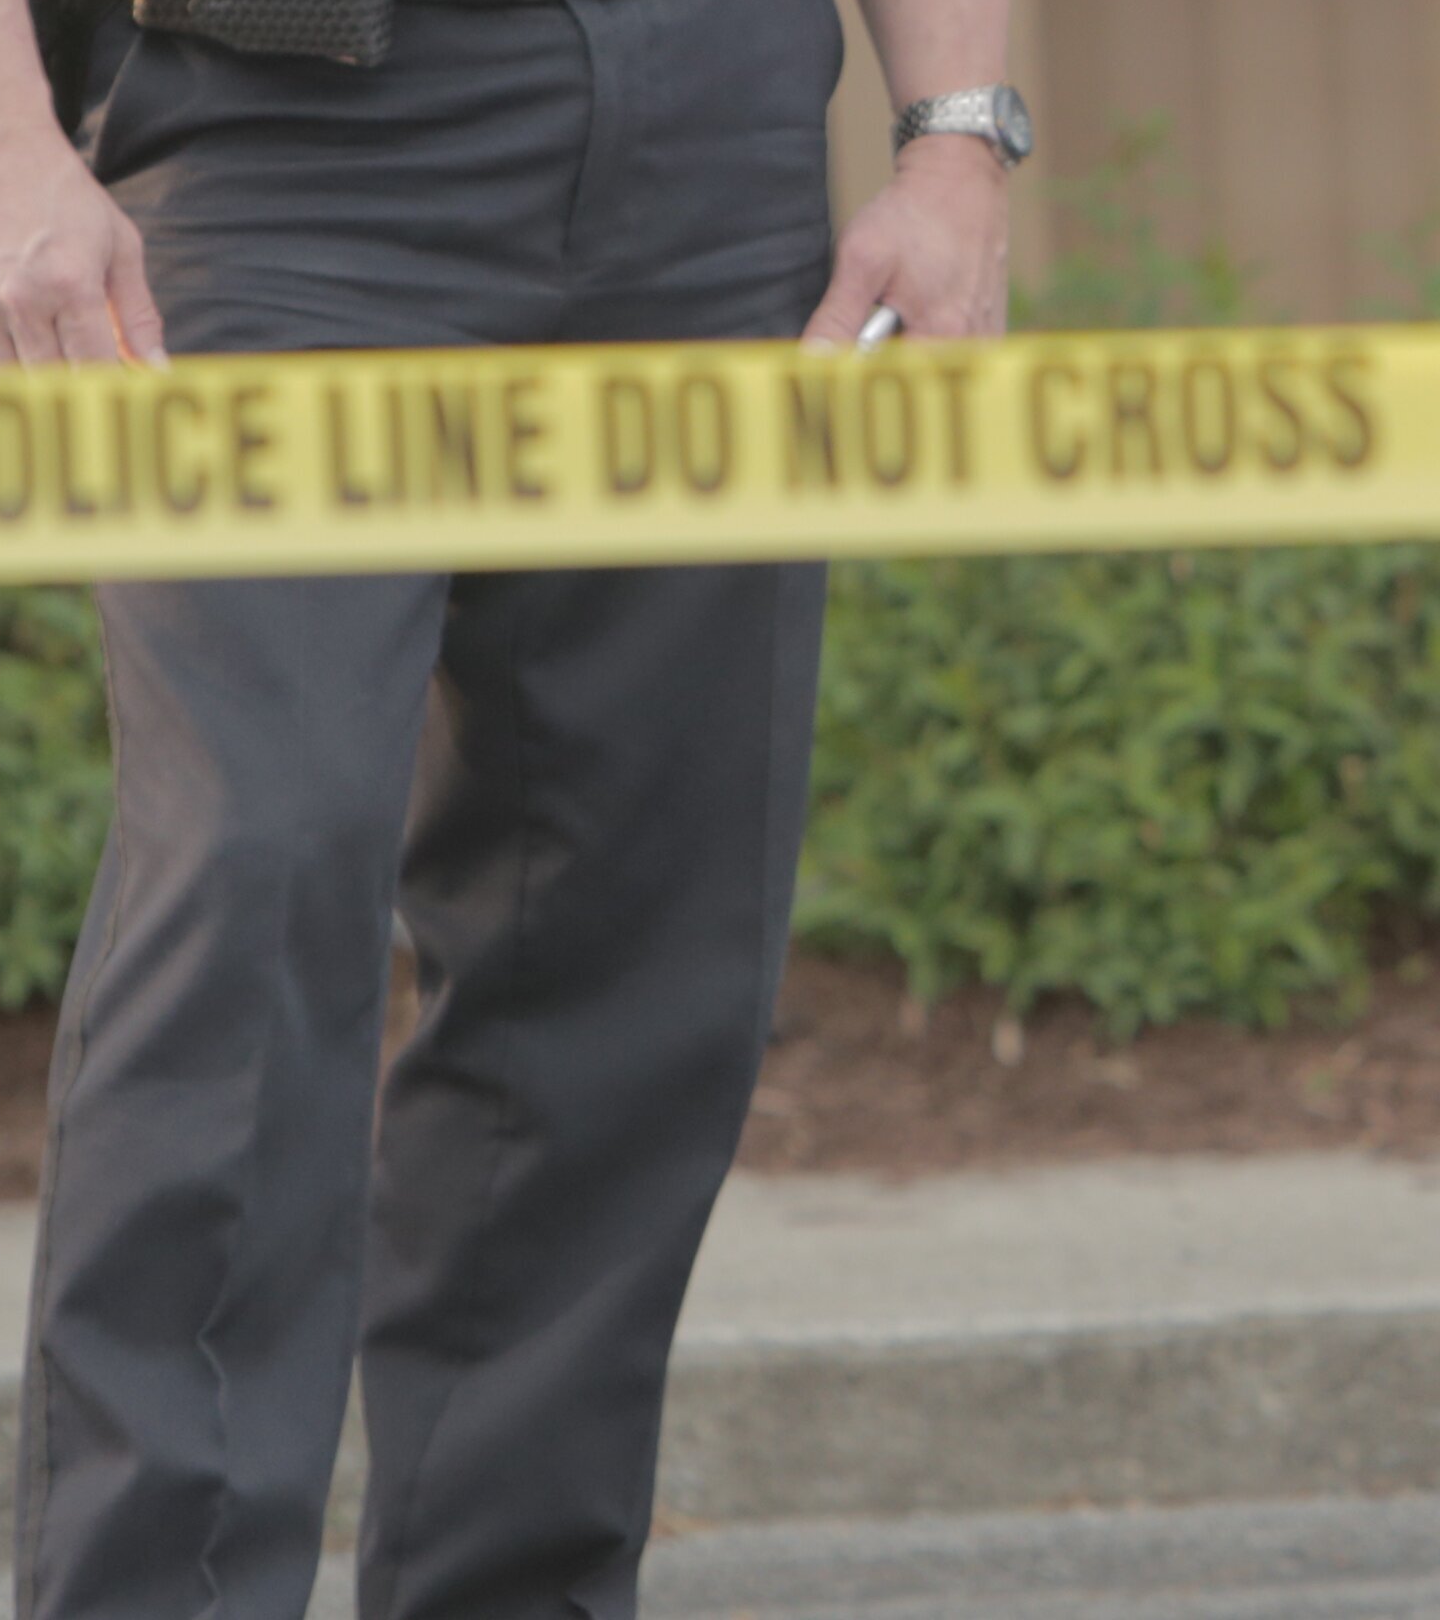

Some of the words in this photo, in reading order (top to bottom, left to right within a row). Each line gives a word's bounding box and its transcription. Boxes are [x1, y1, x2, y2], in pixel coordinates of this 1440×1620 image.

[323, 376, 547, 507] LINE
[602, 370, 733, 496] DO
[783, 360, 978, 487] NOT
[1028, 350, 1376, 481] CROSS
